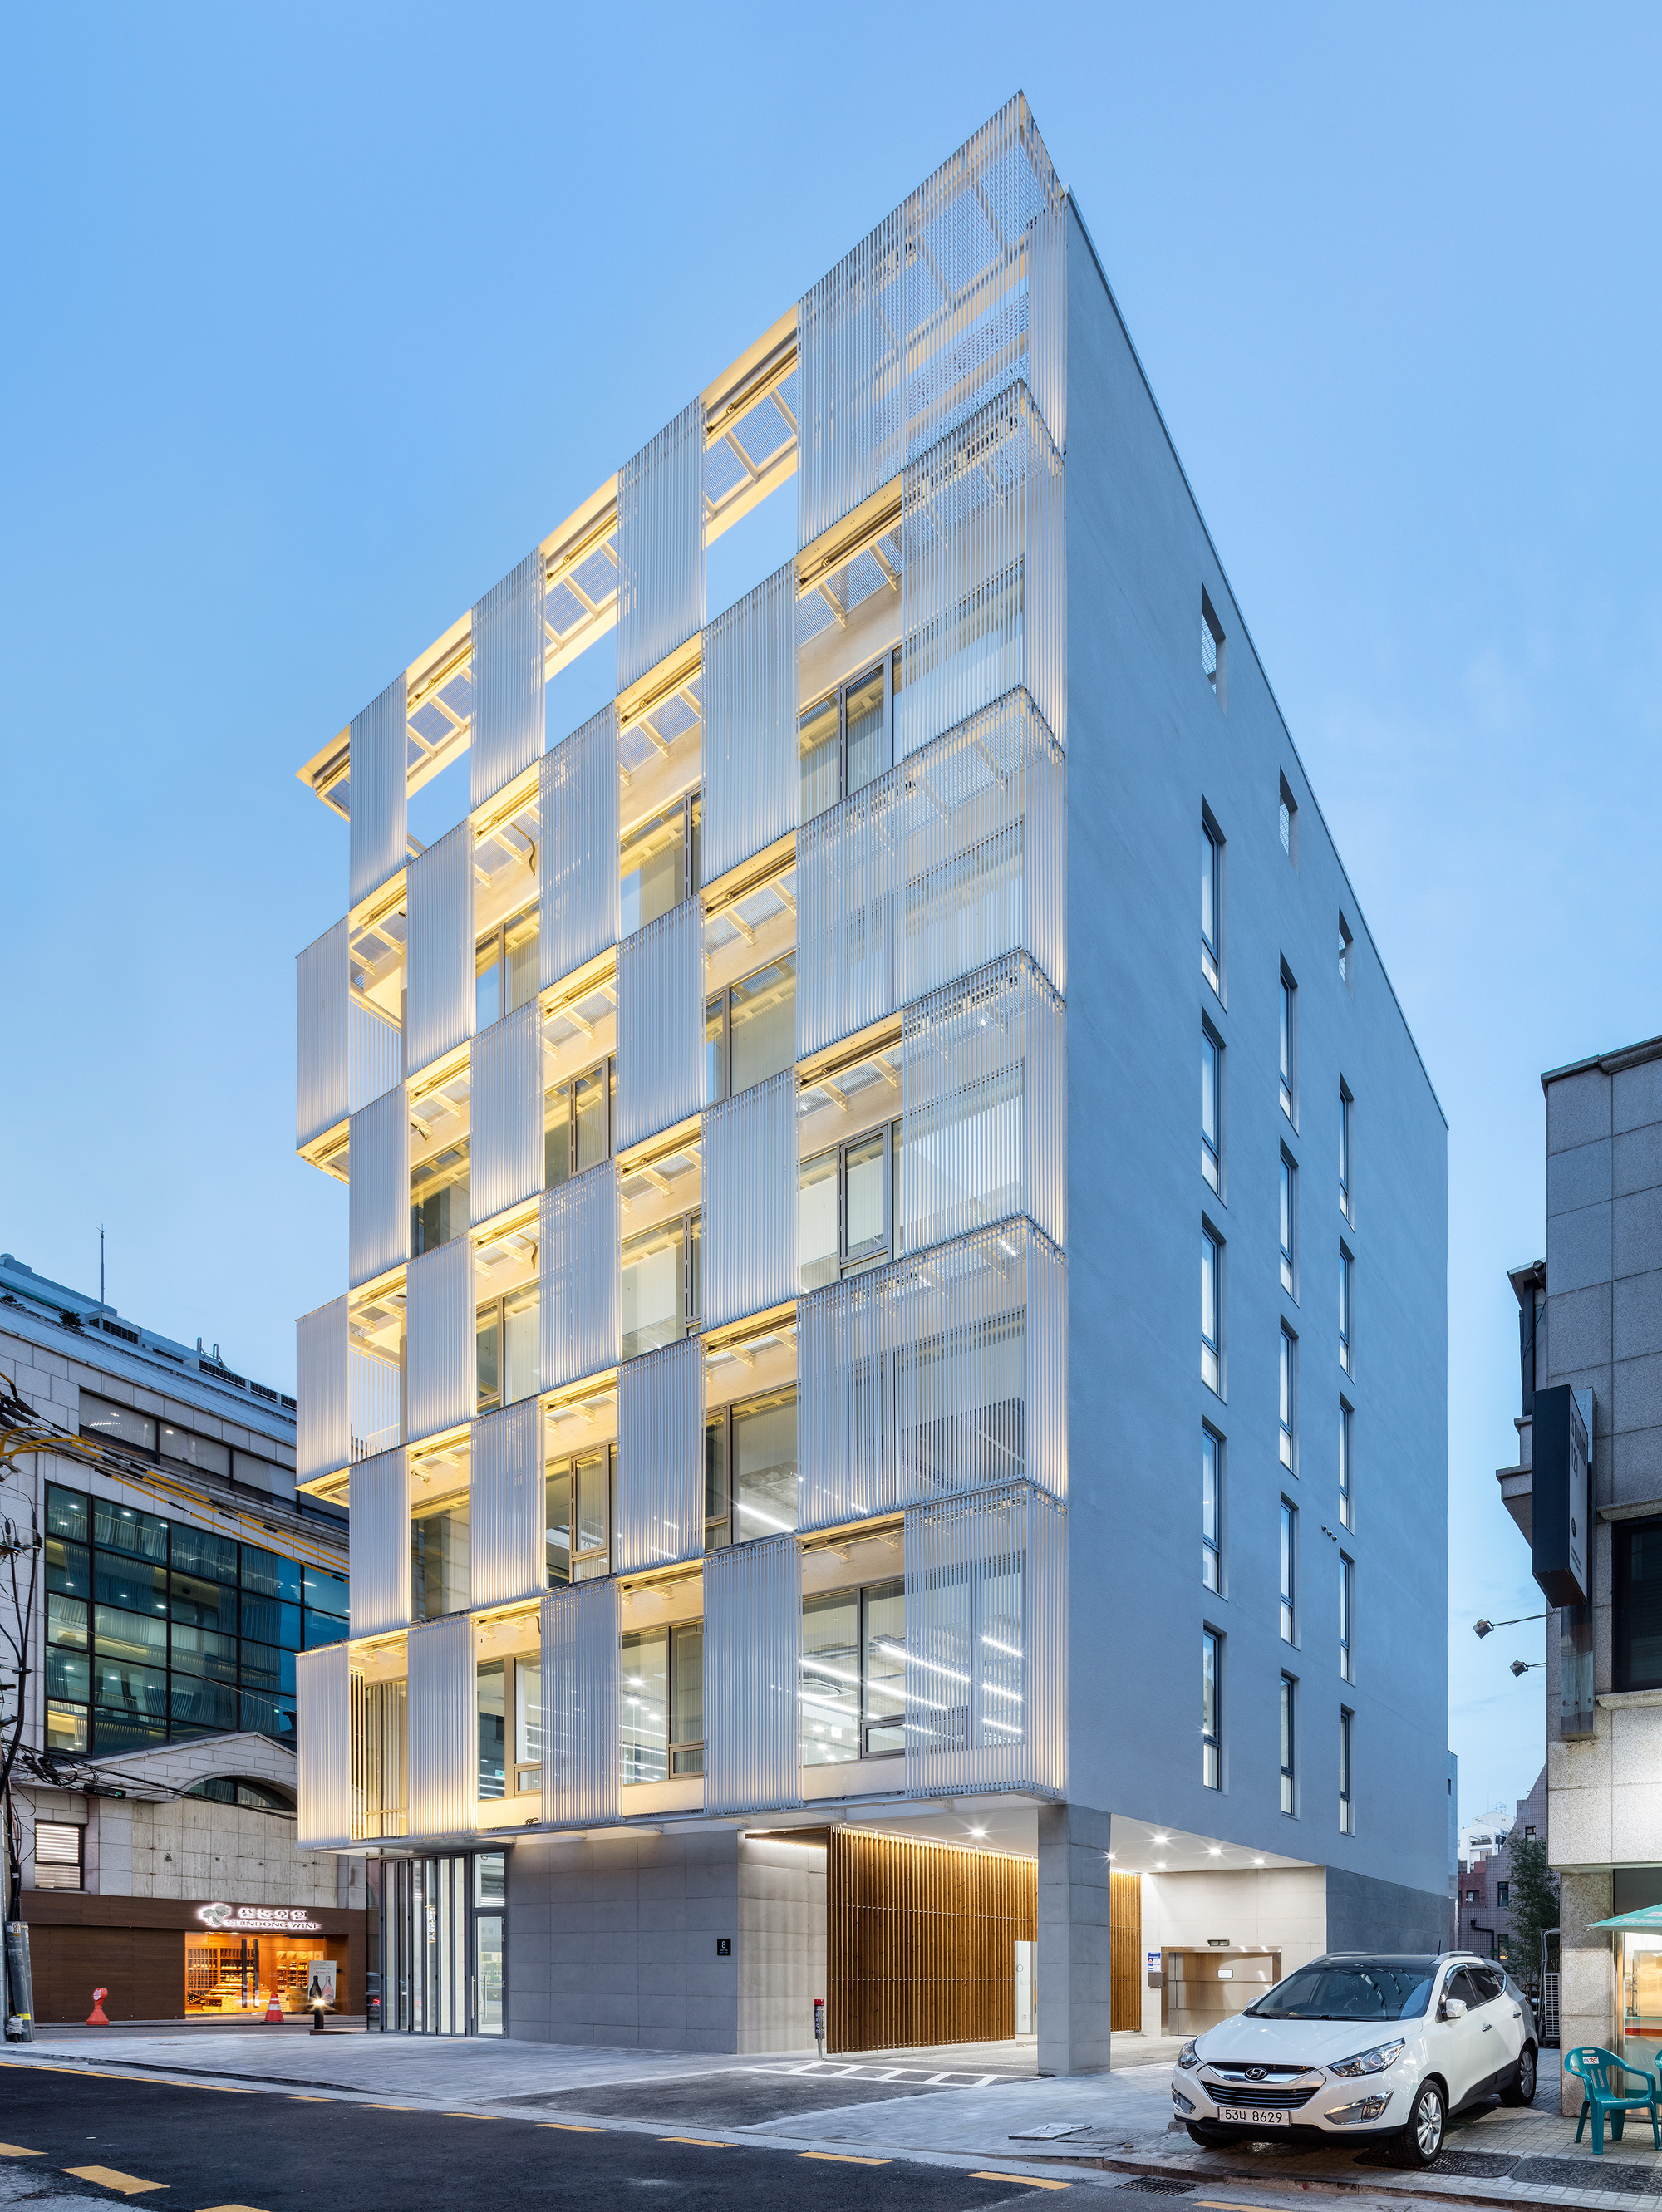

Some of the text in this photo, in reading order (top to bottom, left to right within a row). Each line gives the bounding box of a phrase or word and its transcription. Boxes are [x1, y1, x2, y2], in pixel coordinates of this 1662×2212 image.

[226, 1920, 288, 1928] SHINDONG
[721, 1940, 726, 1949] 8
[1225, 2109, 1283, 2123] 53나 8629
